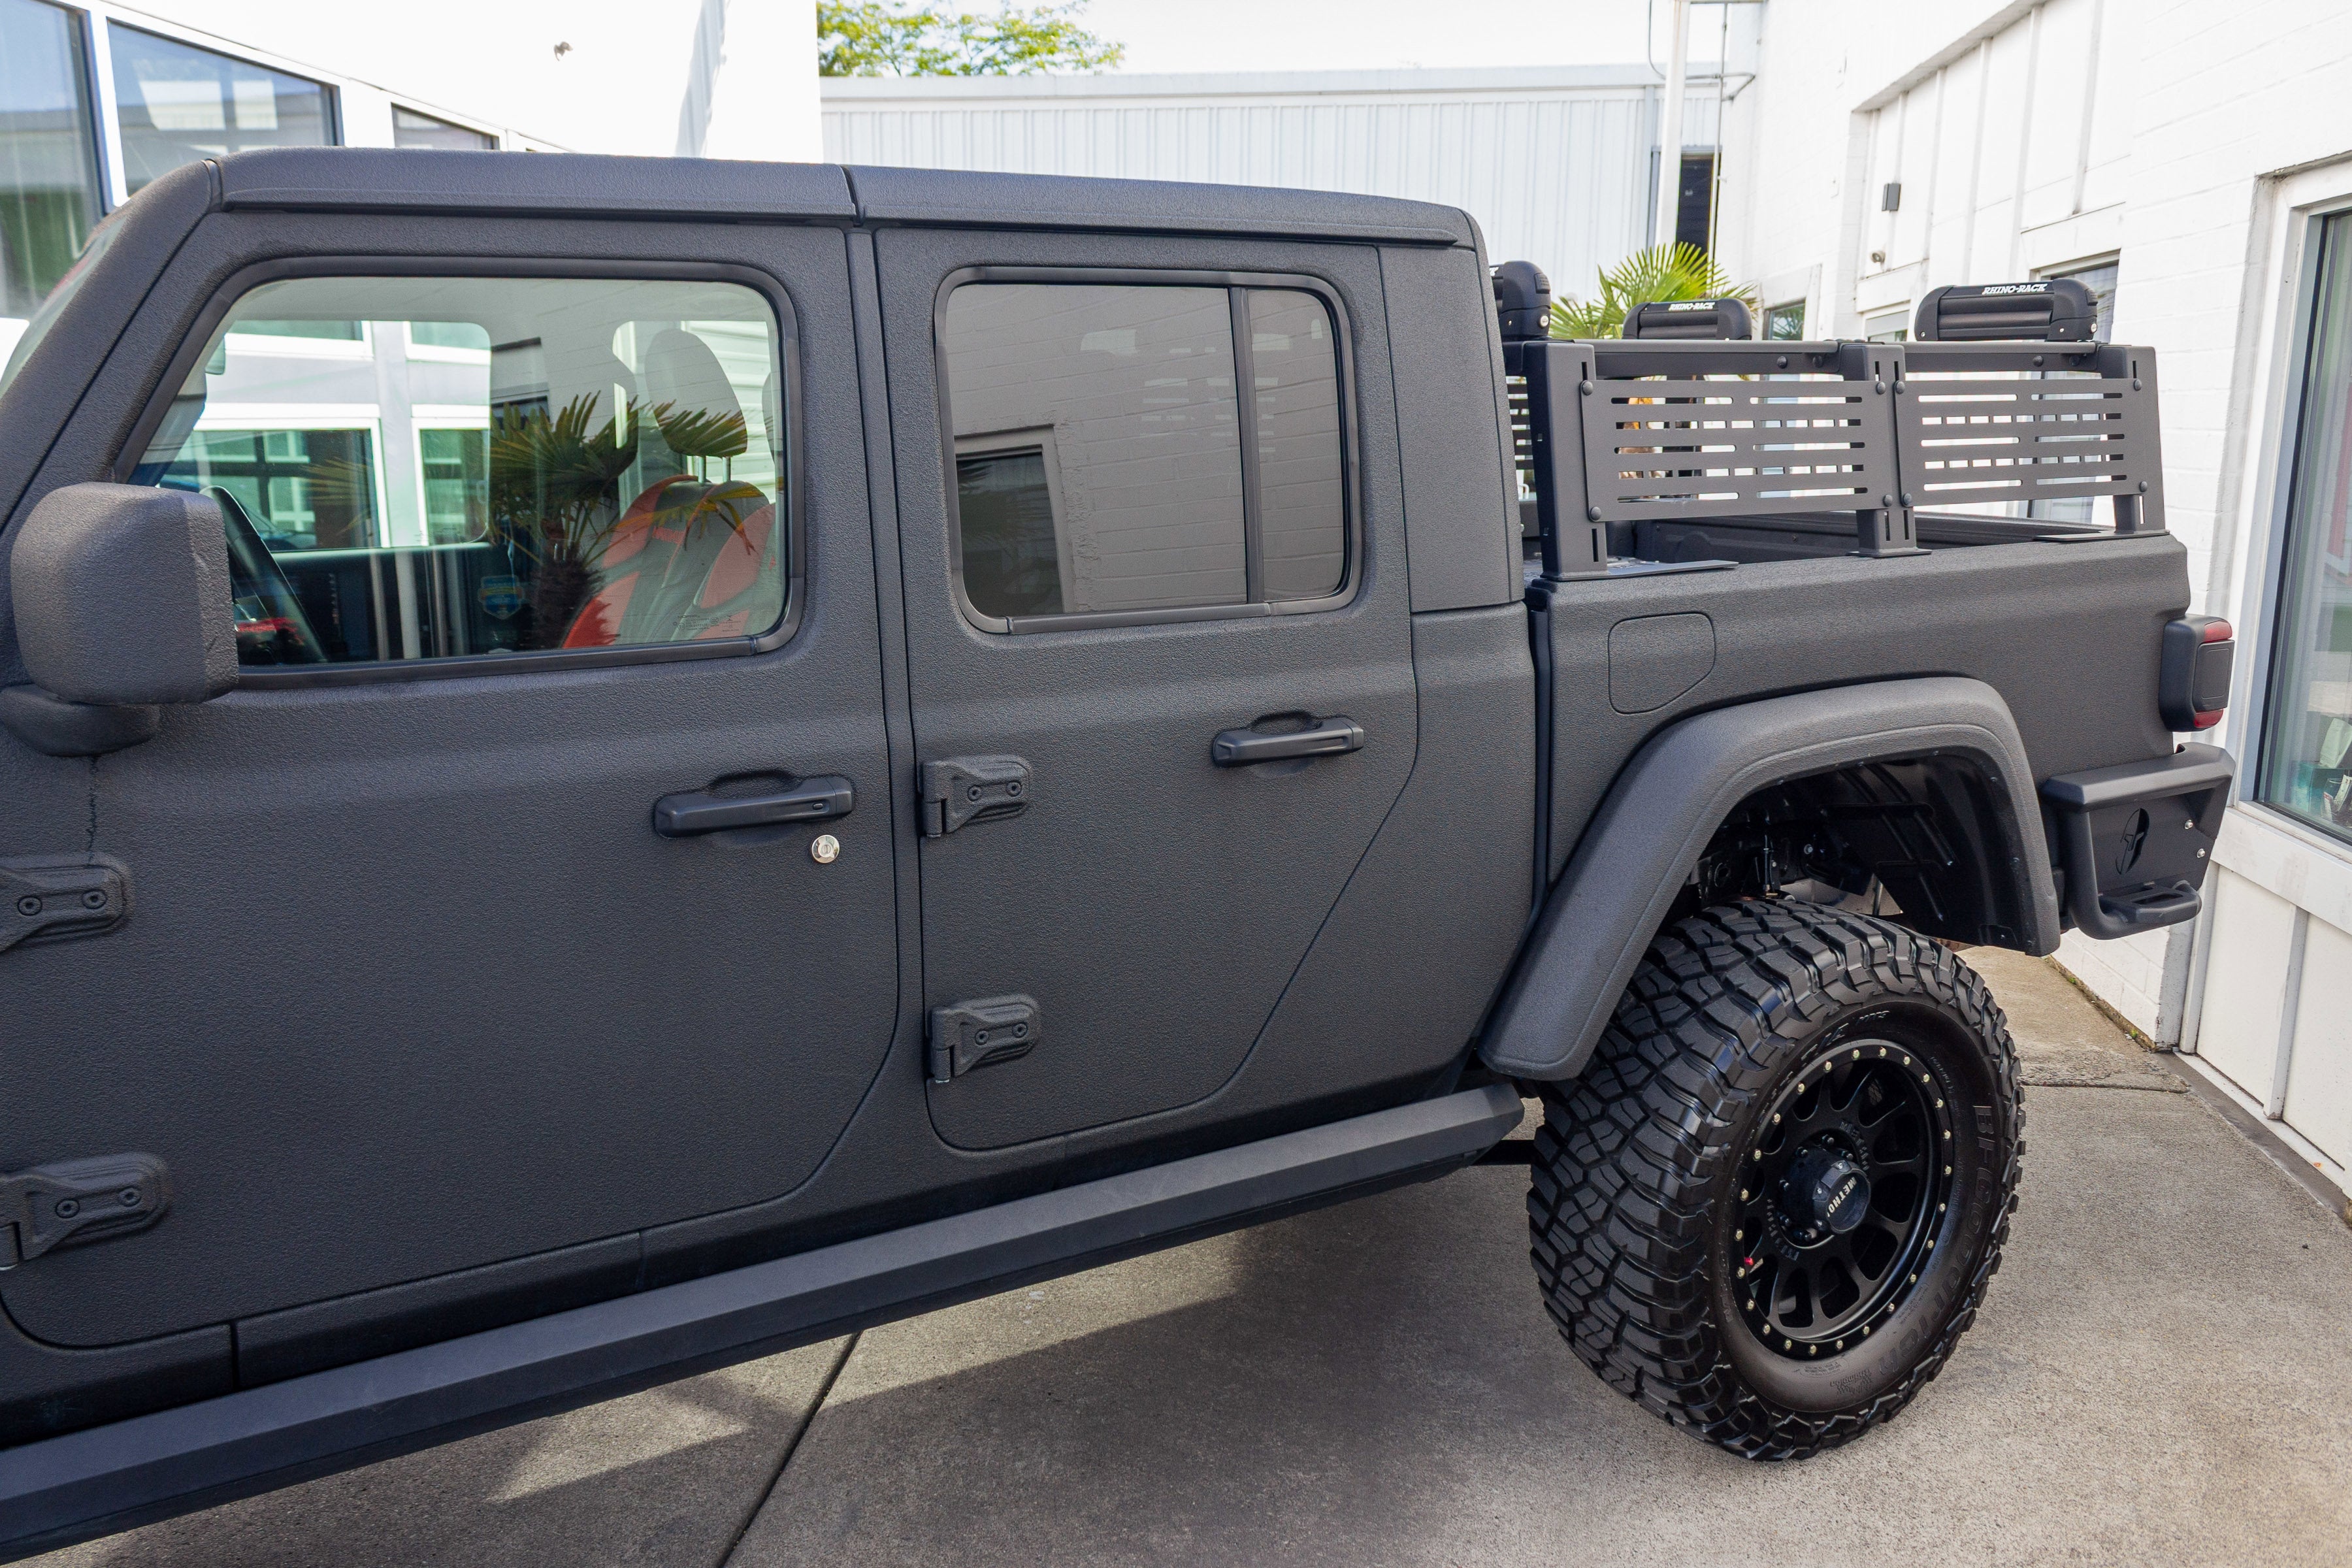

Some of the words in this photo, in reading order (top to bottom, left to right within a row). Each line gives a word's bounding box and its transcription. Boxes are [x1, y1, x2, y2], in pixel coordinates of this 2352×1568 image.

[1982, 284, 2048, 295] RHINO-RACK
[1669, 302, 1715, 312] RHINO-RACK
[1827, 1176, 1857, 1217] METHO
[1878, 1105, 1996, 1375] BFGoodrich
